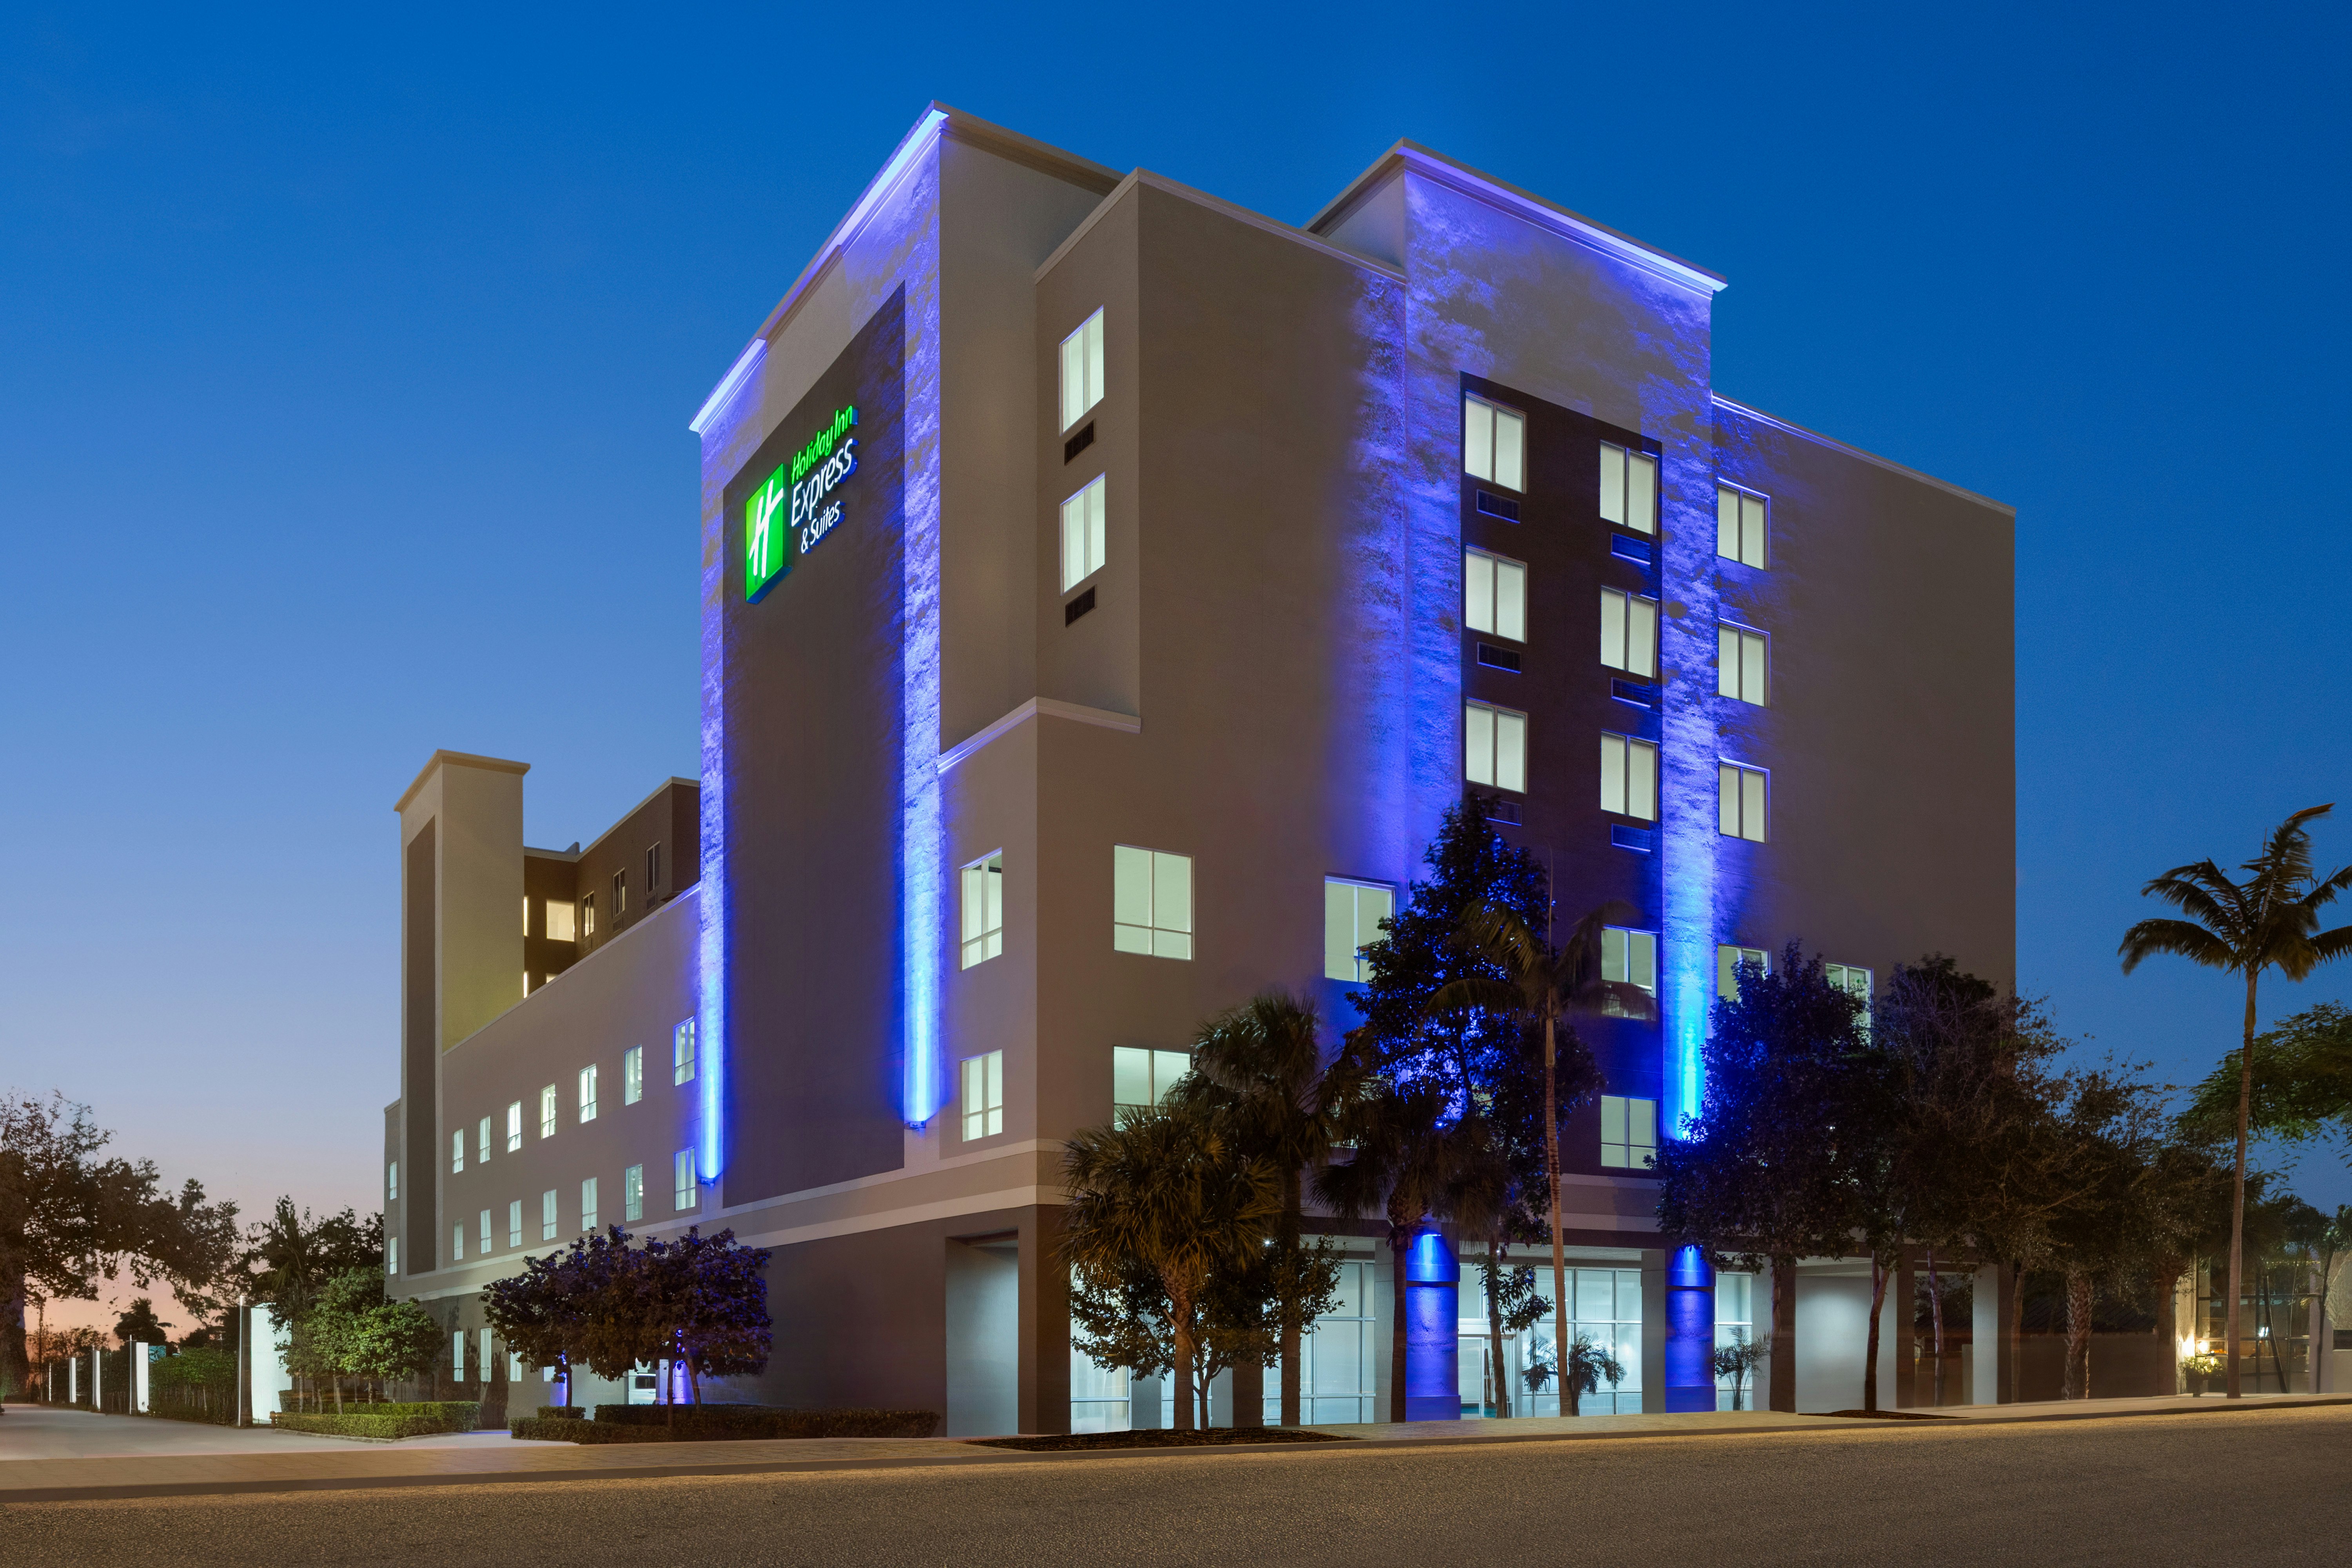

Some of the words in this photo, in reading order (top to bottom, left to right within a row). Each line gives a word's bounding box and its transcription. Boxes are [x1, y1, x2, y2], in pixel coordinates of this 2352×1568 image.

[791, 425, 833, 485] Holiday
[834, 405, 853, 440] Inn
[791, 438, 853, 527] Express
[800, 527, 808, 554] &
[810, 501, 840, 545] Suites
